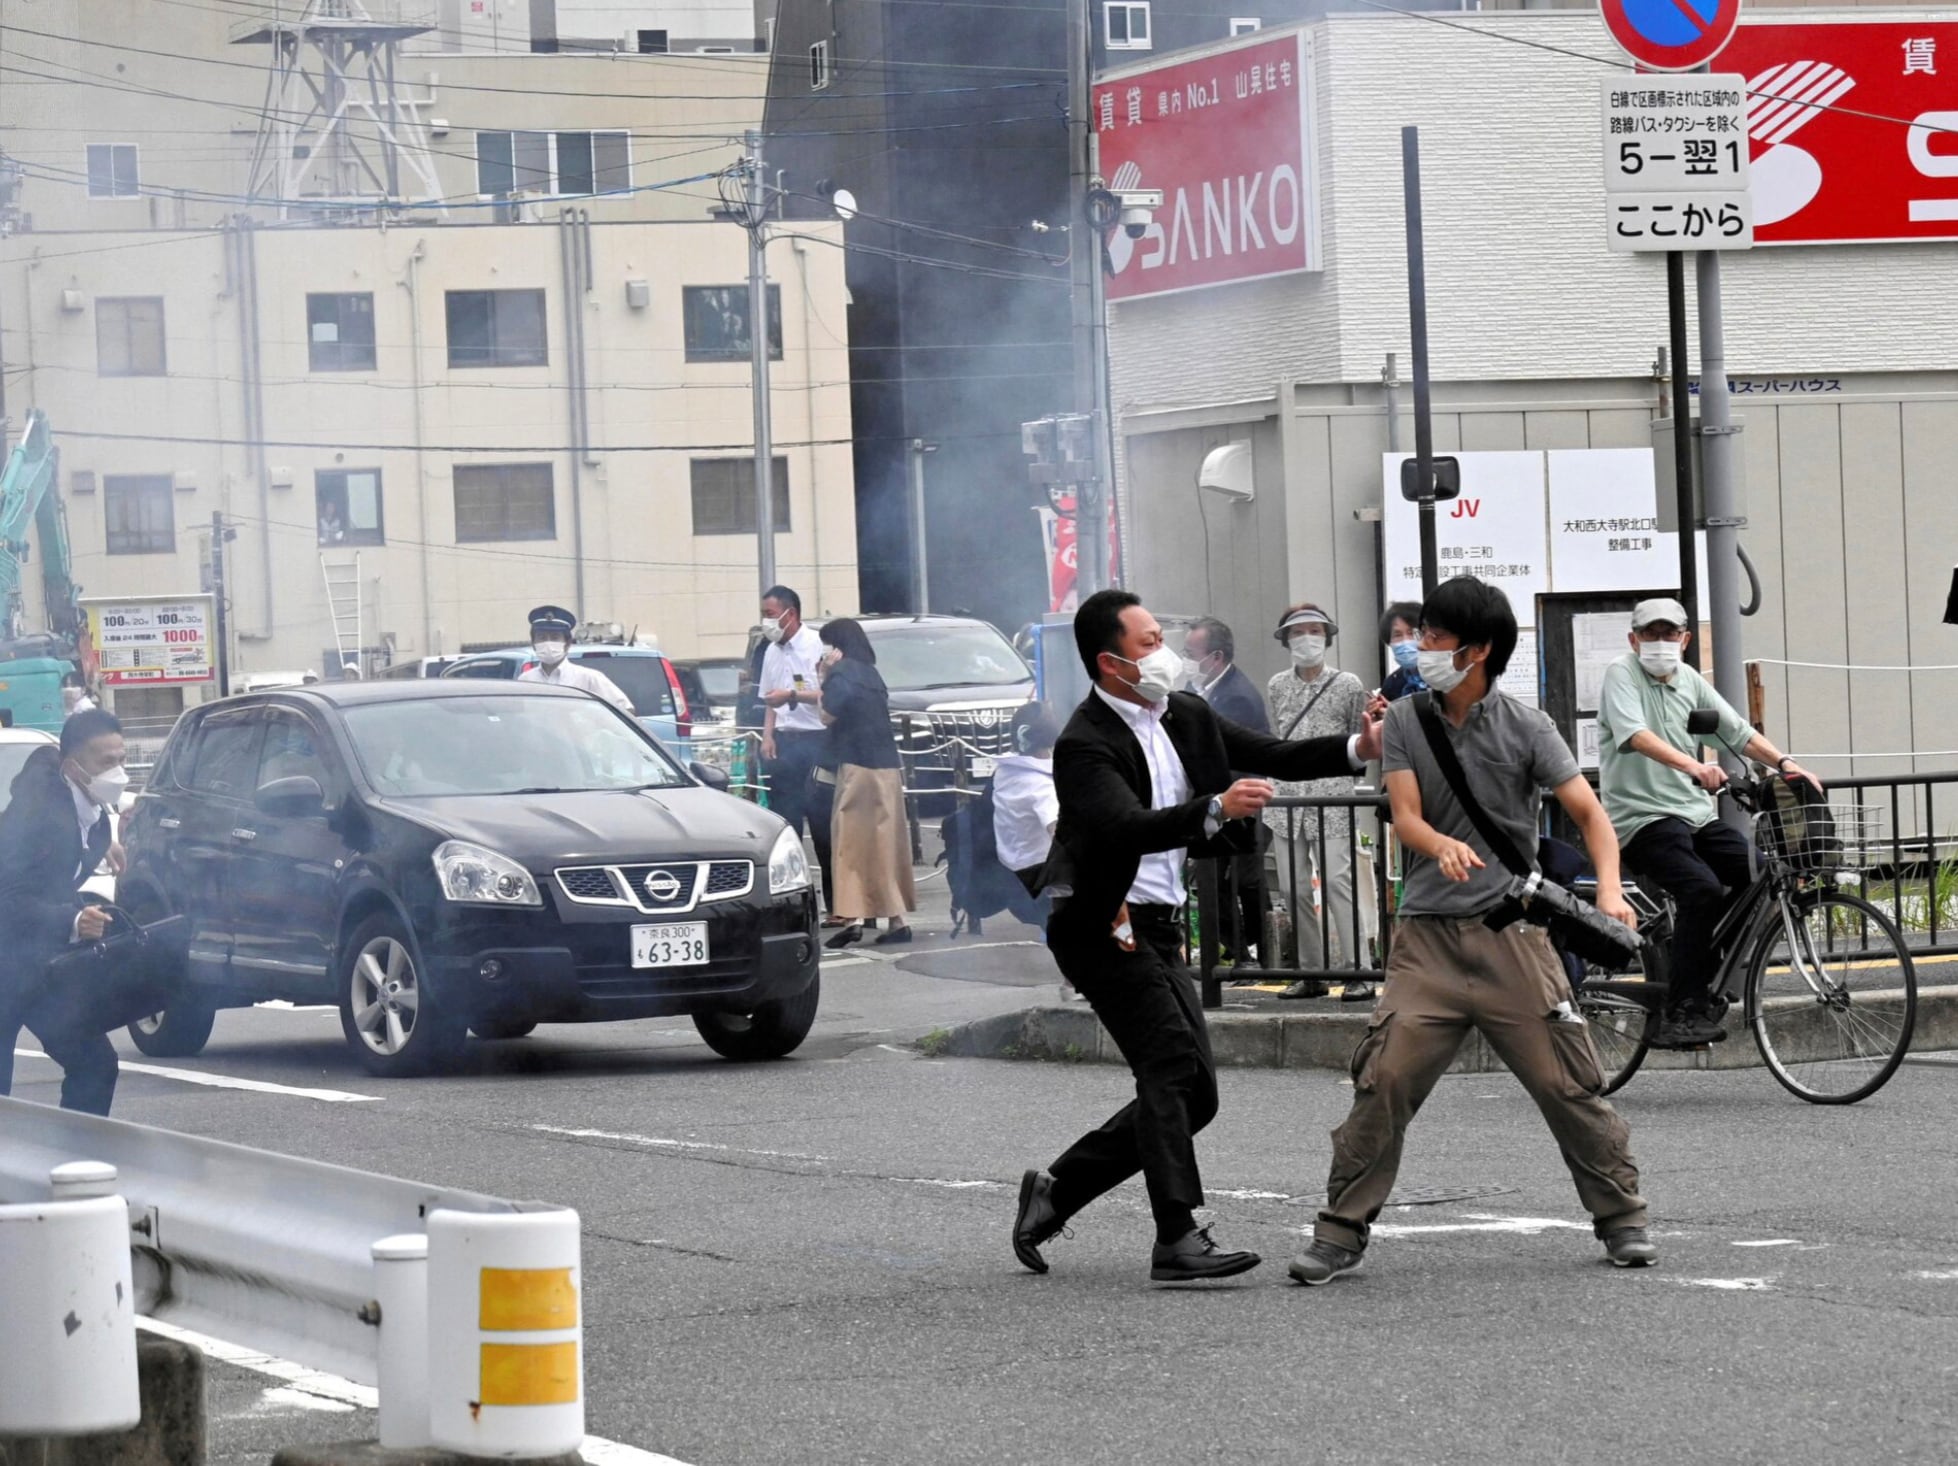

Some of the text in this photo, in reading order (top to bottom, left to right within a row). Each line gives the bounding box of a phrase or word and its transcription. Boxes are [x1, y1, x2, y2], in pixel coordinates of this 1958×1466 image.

[1901, 38, 1937, 76] 賃
[1187, 78, 1219, 109] No.1
[1610, 90, 1740, 108] 白線で区画標示された区域内の
[1610, 115, 1740, 134] 路線バス・タクシーを除く
[1616, 202, 1744, 237] ここから
[1450, 499, 1480, 518] JV
[1608, 537, 1652, 551] 整備工事
[1402, 564, 1531, 579] 特定設工事共同企業体
[648, 940, 704, 963] 63-38
